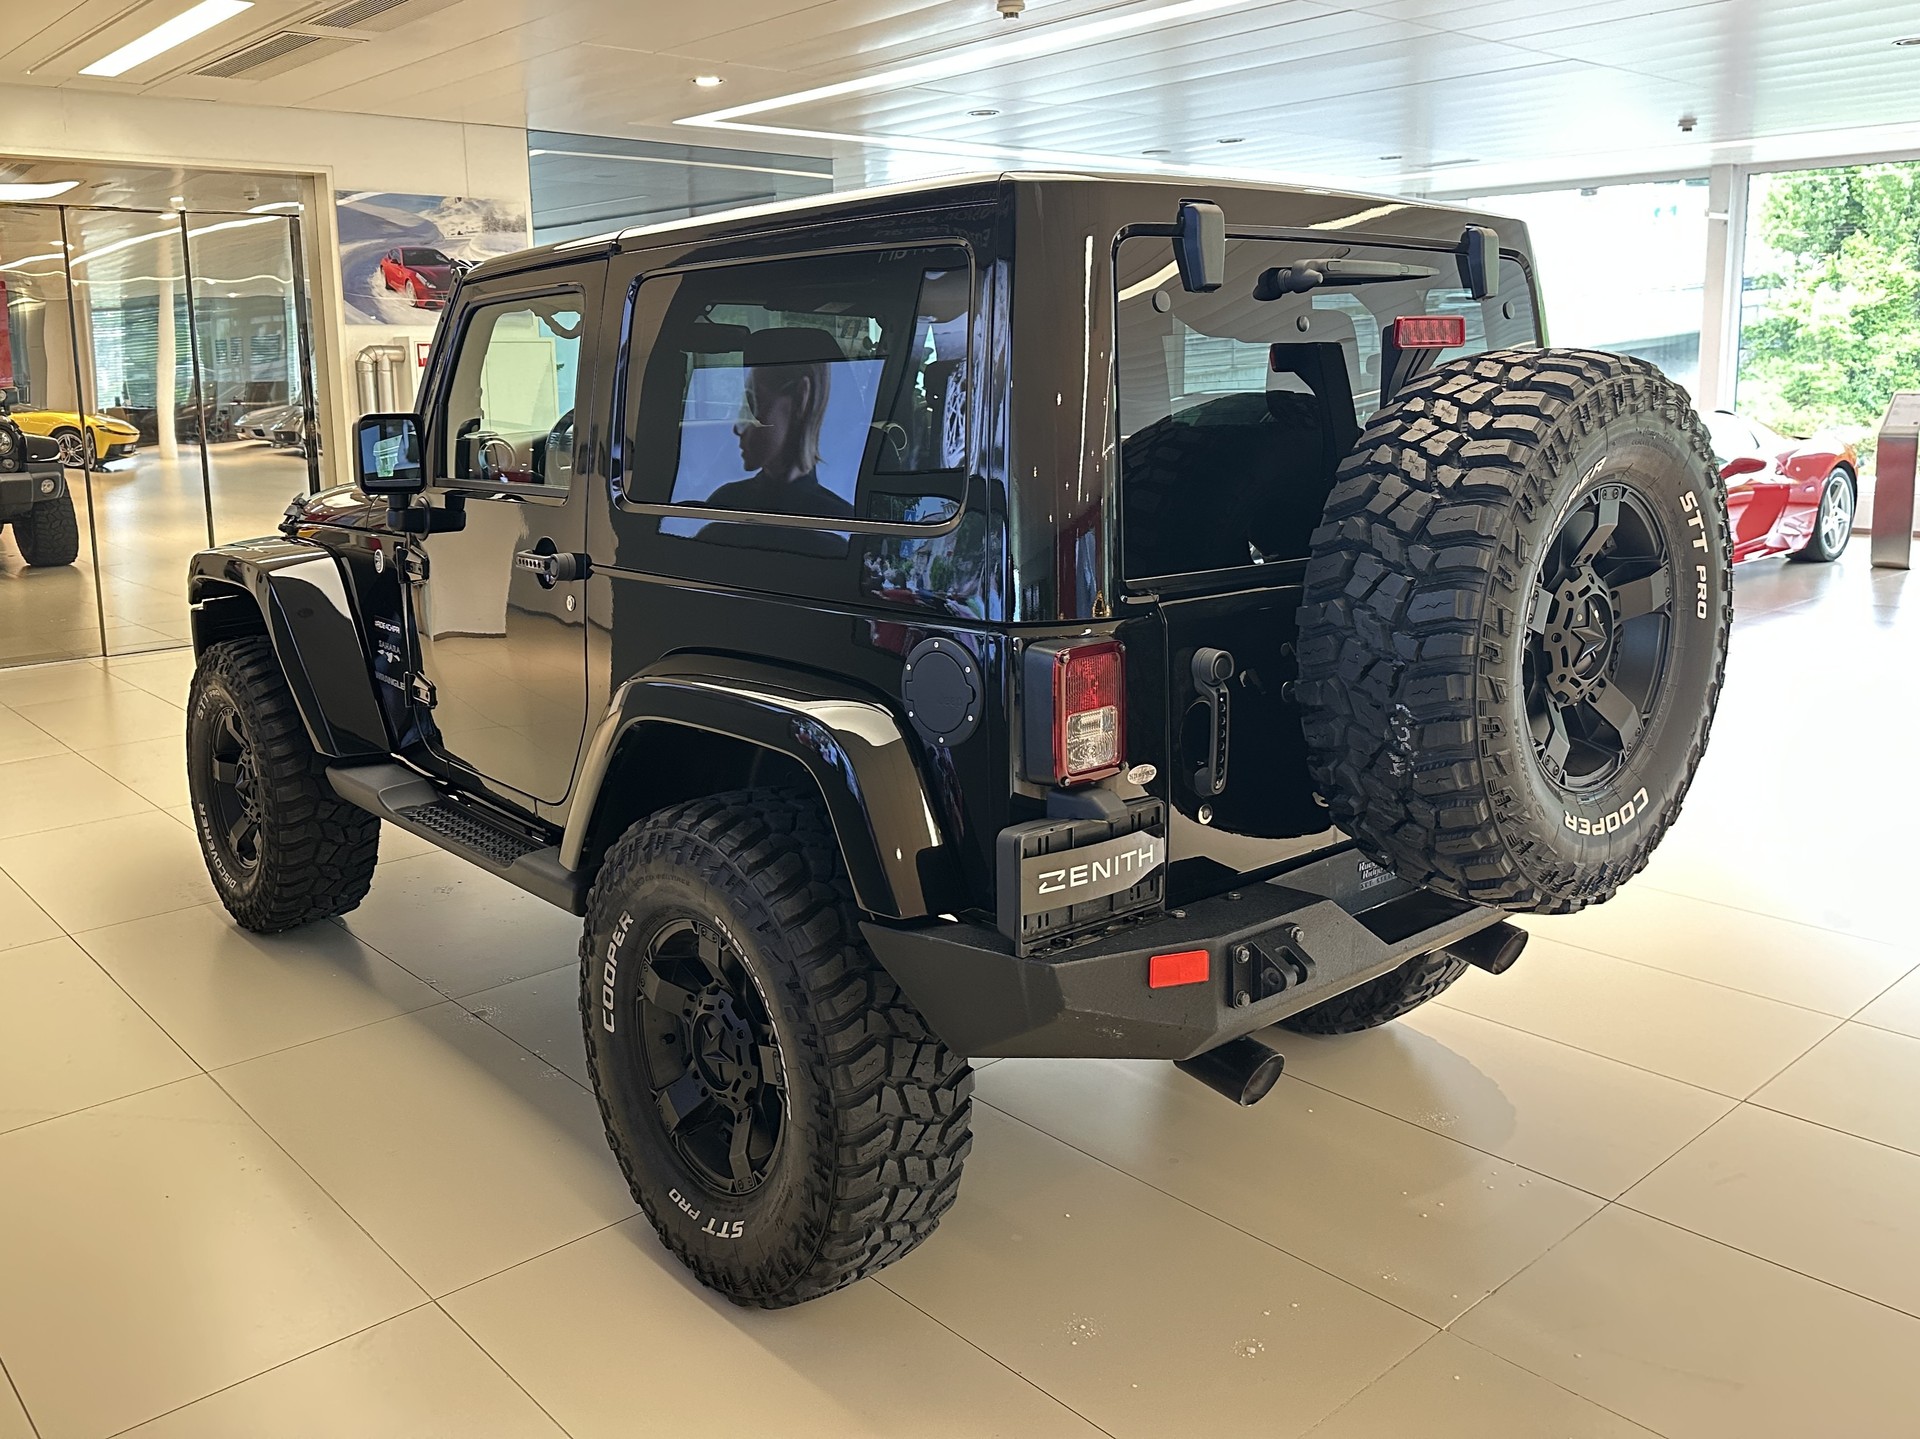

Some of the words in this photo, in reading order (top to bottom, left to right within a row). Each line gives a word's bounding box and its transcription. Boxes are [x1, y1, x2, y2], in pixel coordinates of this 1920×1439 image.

[1679, 490, 1709, 553] STT
[1695, 564, 1708, 620] PRO
[375, 670, 405, 691] WRANGLE
[197, 692, 210, 720] STT
[1563, 787, 1650, 836] COOPER
[199, 802, 237, 889] DISCOVERER
[1038, 844, 1154, 895] ZENITH
[602, 910, 635, 1033] COOPER
[668, 1188, 701, 1221] PRO
[701, 1217, 745, 1239] STT
